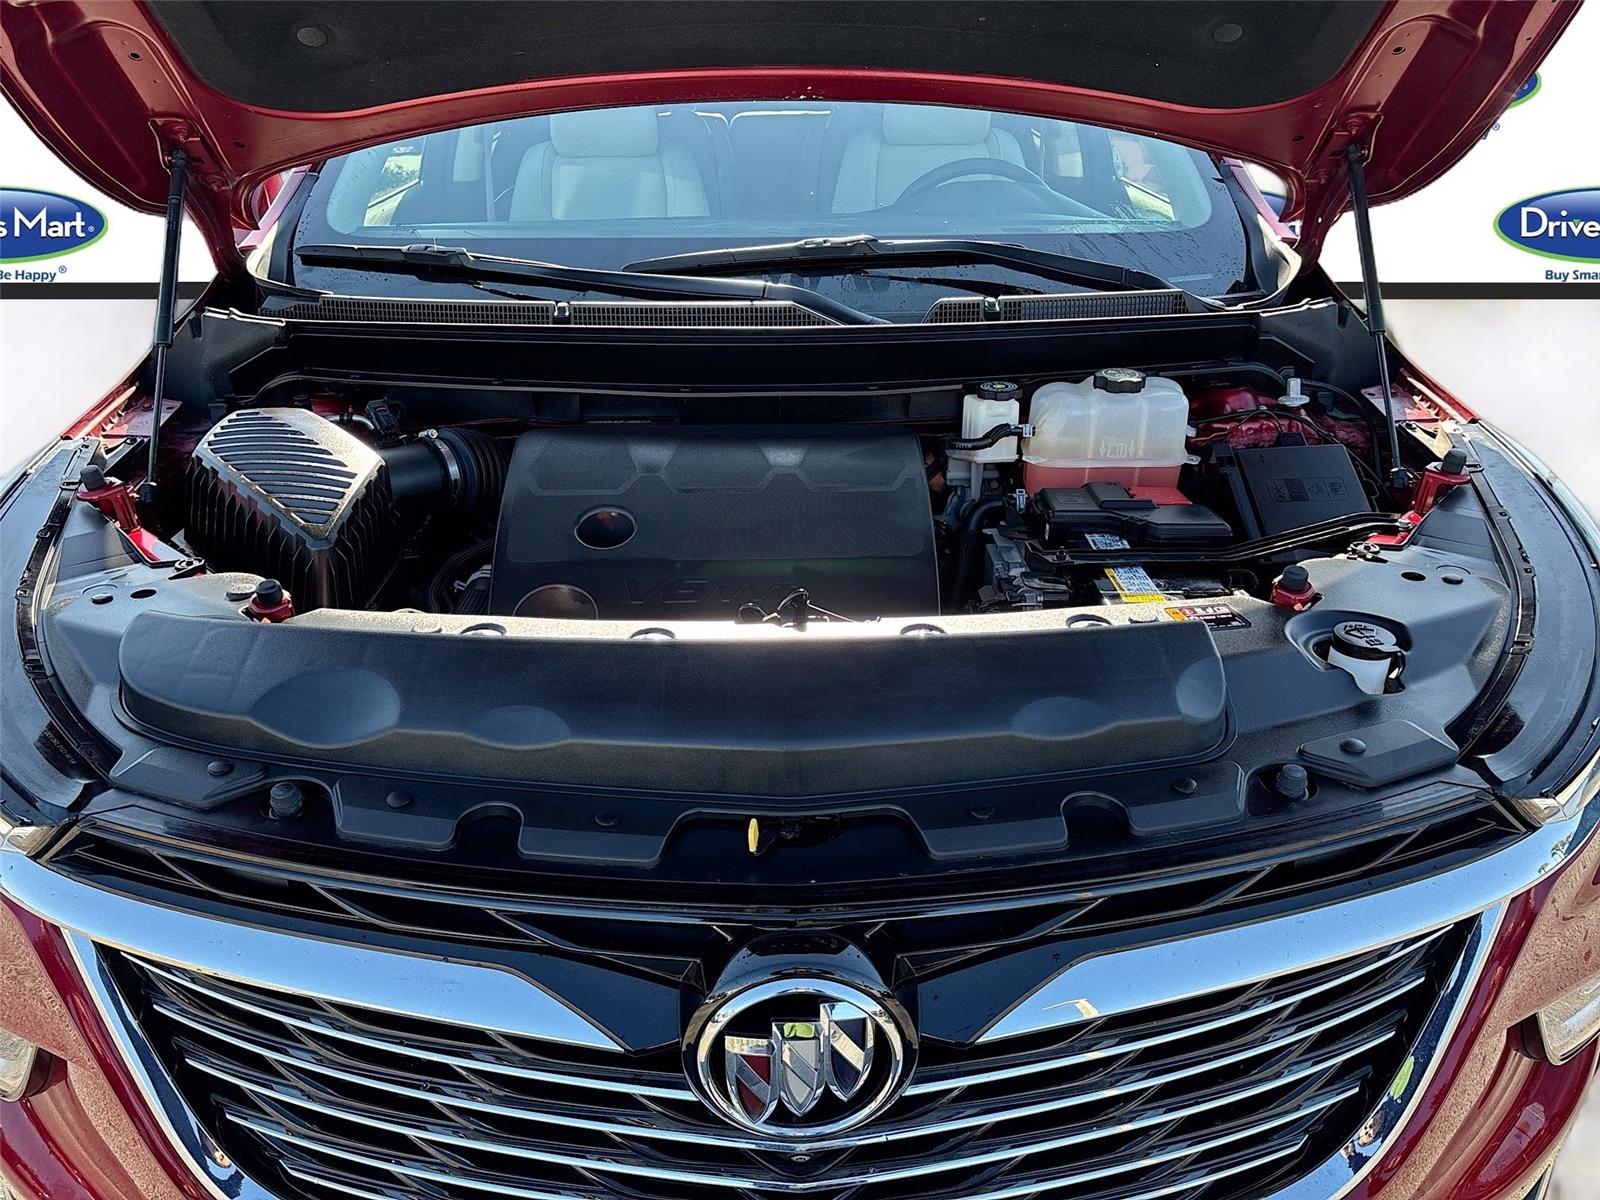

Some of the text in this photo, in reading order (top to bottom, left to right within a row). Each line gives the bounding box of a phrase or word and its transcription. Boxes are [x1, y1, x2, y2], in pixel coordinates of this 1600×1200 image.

[14, 206, 86, 238] Mart
[1520, 206, 1600, 238] Drive
[15, 269, 57, 283] Happy
[1545, 269, 1570, 283] Buy
[624, 577, 710, 604] V6
